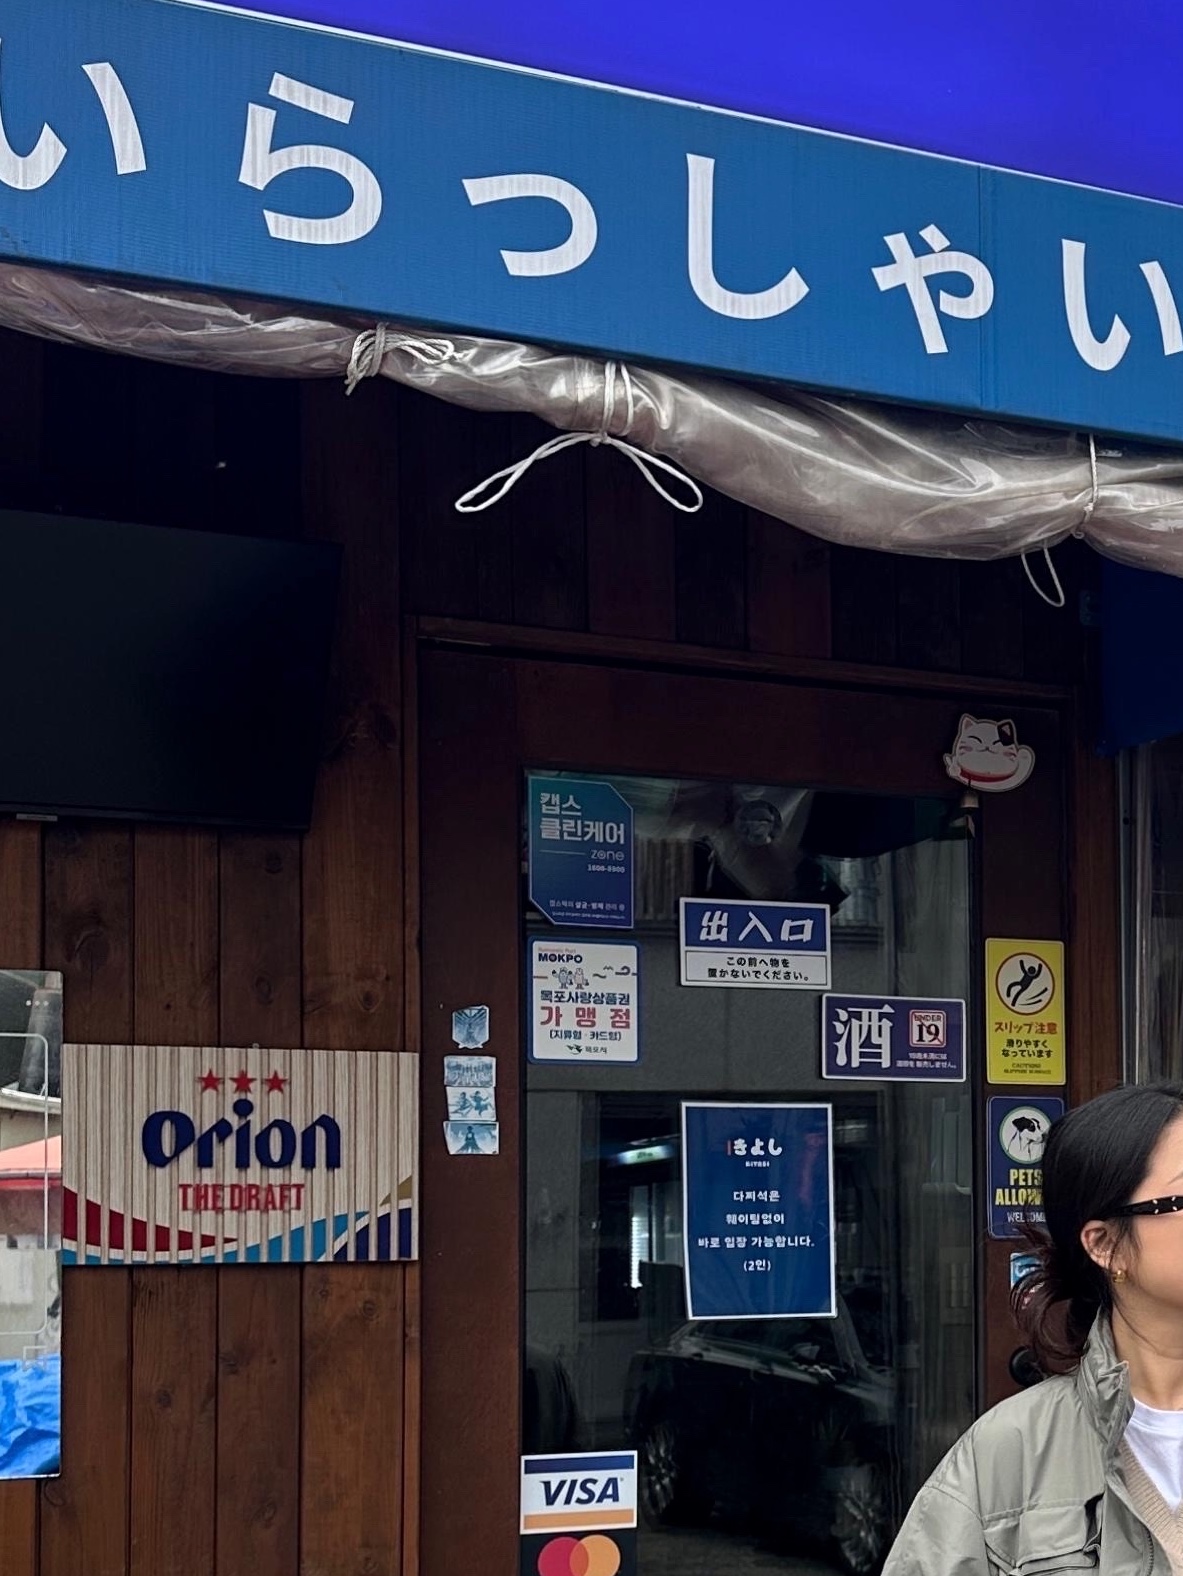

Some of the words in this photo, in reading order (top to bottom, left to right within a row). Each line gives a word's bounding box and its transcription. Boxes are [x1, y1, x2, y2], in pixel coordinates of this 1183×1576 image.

[539, 792, 581, 815] 캡스
[539, 817, 625, 844] 클린케어
[591, 850, 625, 861] zone
[700, 910, 814, 943] 出入口
[538, 953, 583, 964] MOKPO
[726, 956, 790, 968] この前へ物を
[707, 968, 809, 982] 置かないでください。
[540, 990, 630, 1006] 목포사랑상품권
[914, 1014, 942, 1022] UNDER
[916, 1023, 940, 1043] 19
[994, 1021, 1058, 1035] スリップ注意
[833, 1004, 894, 1068] 酒
[1006, 1038, 1048, 1048] 滑りやすく
[1001, 1049, 1053, 1058] なっています
[733, 1138, 783, 1156] きよし
[1009, 1168, 1043, 1186] PETS
[179, 1183, 231, 1211] THE
[233, 1183, 305, 1211] DRAFT
[698, 1236, 721, 1249] 바로
[724, 1237, 747, 1249] 입장
[751, 1235, 815, 1249] 가능합니다.
[743, 1259, 772, 1272] (2인)
[540, 1477, 620, 1507] VISA
